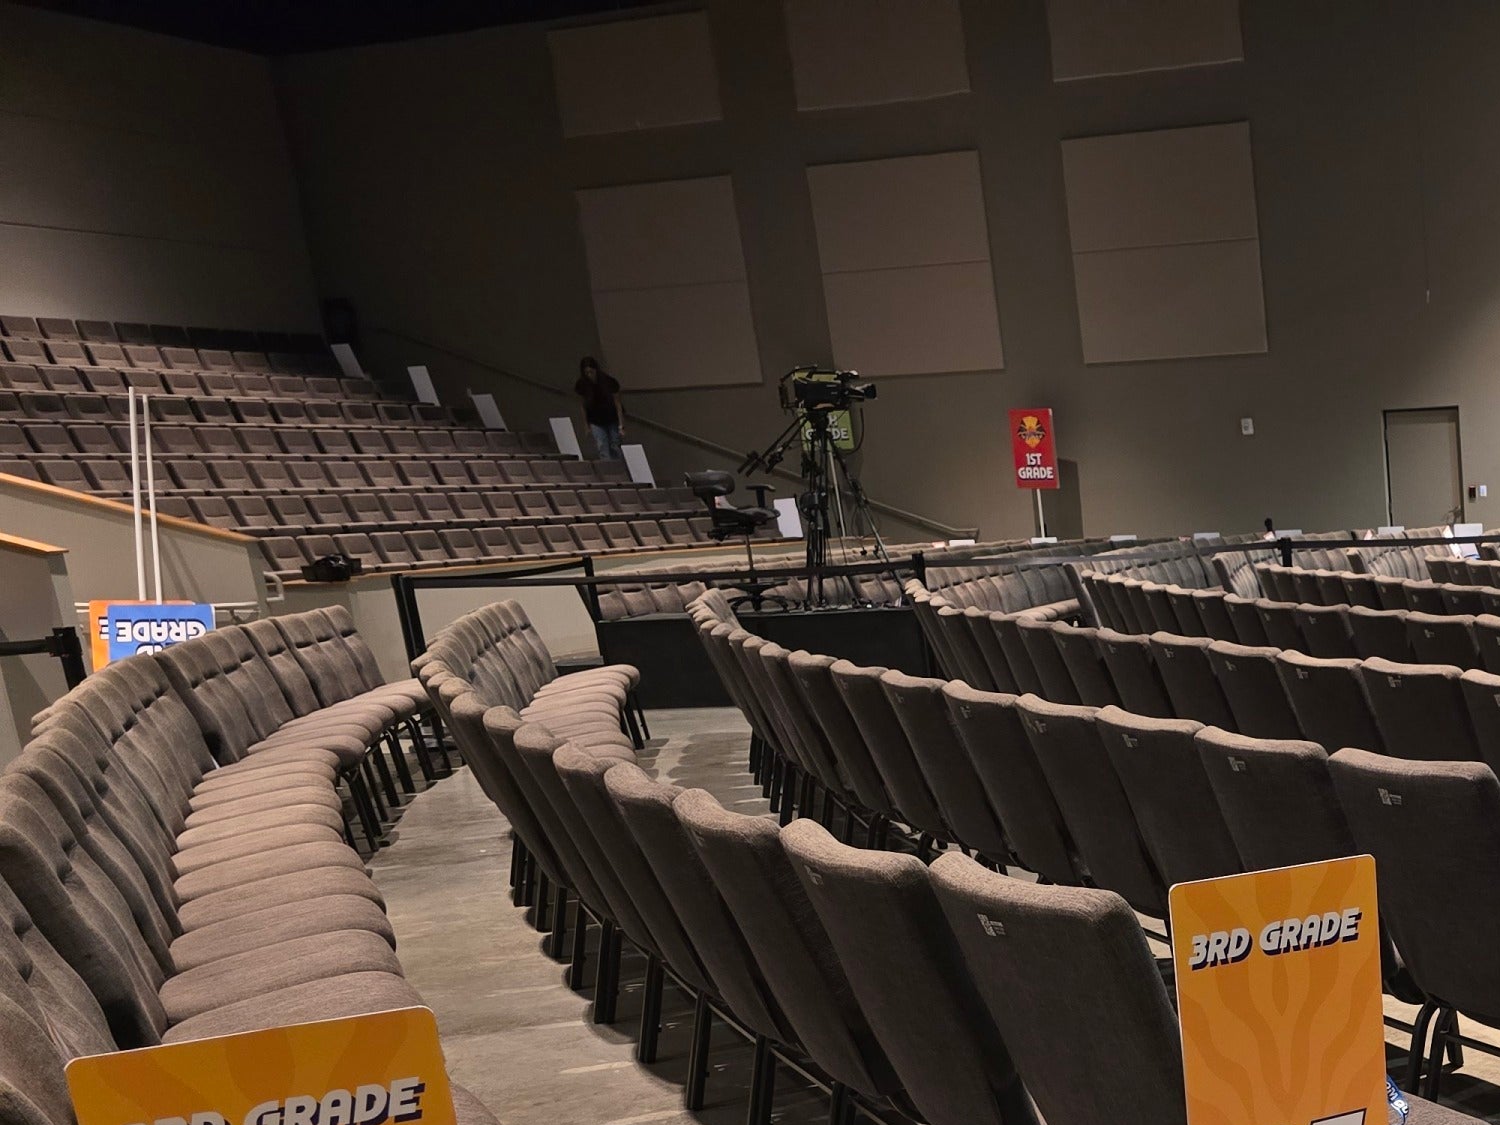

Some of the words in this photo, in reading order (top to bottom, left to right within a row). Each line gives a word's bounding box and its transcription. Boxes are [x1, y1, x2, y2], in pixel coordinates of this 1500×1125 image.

[1025, 453, 1042, 466] 1ST
[1018, 466, 1054, 480] GRADE
[115, 619, 207, 643] GRADE
[1188, 927, 1252, 970] 3RD
[1259, 907, 1362, 956] GRADE
